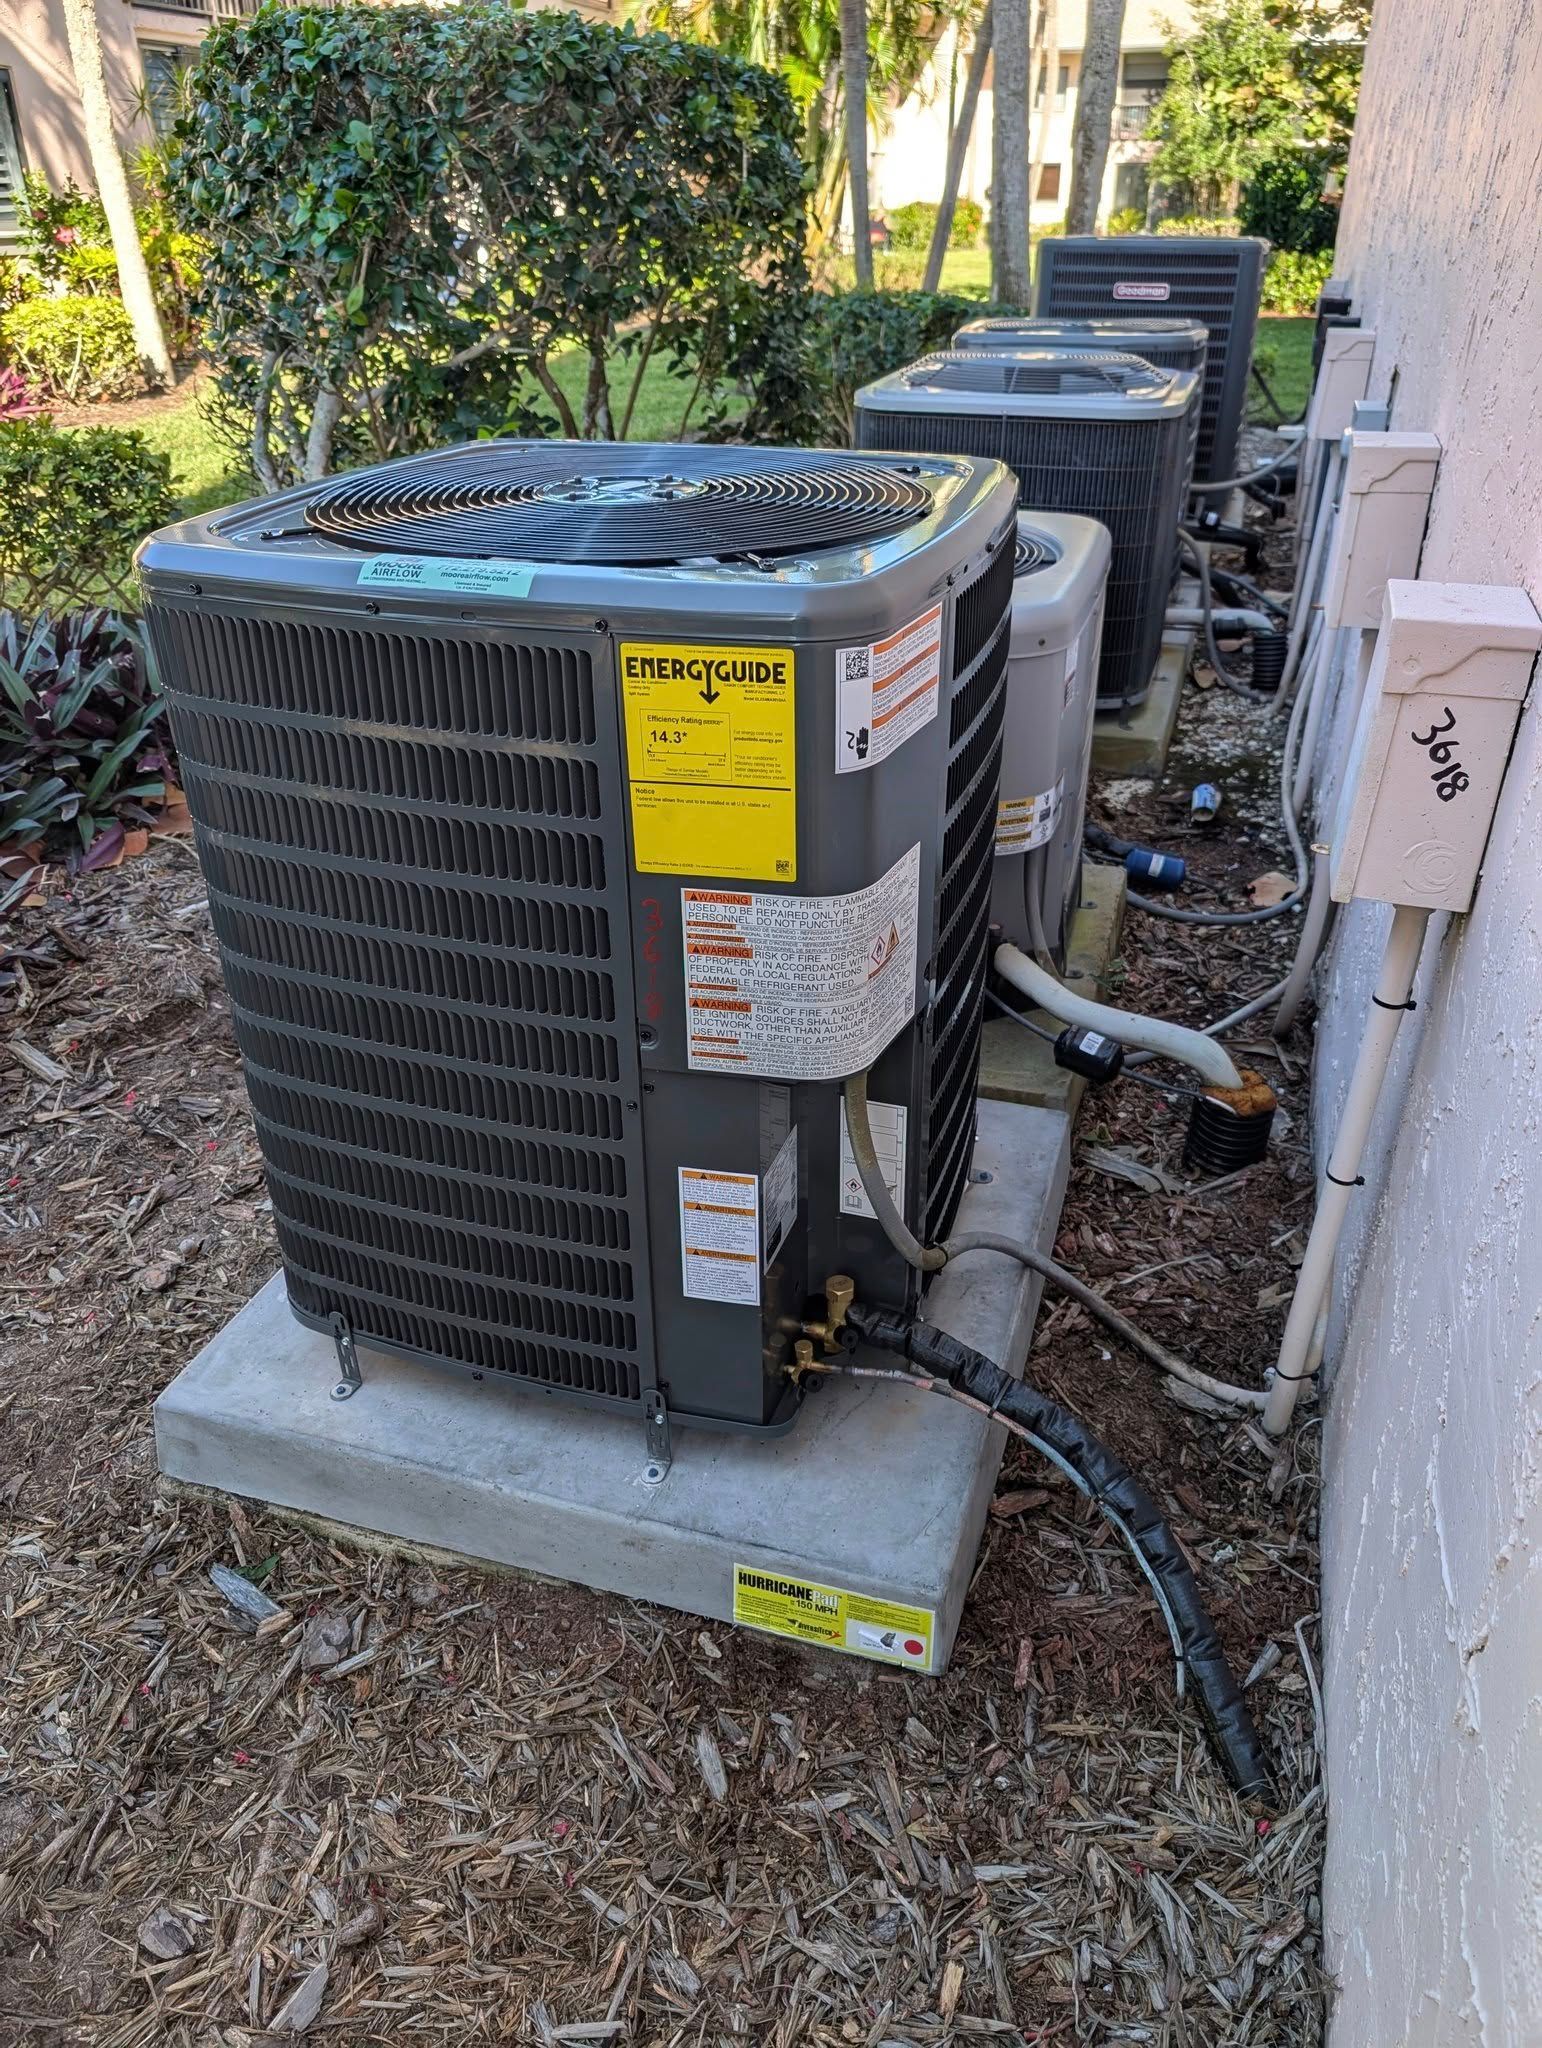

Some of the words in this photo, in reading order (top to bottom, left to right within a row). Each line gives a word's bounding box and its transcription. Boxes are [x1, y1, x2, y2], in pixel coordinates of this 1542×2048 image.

[1117, 286, 1165, 296] Goodman
[371, 568, 423, 578] AIRFLOW
[374, 561, 428, 570] MOORE
[440, 572, 509, 582] mooreairflow.com
[625, 656, 787, 688] ENERGYGUIDE
[647, 714, 679, 724] Efficiency
[680, 716, 702, 726] Rating
[1411, 706, 1470, 803] 3618
[688, 902, 720, 913] USED.
[722, 906, 737, 914] TO
[740, 907, 753, 916] BE
[756, 908, 808, 920] REPAIRED
[812, 910, 842, 920] ONLY
[842, 907, 856, 918] BY
[857, 891, 882, 912] TRAINED
[698, 892, 749, 906] WARNING
[756, 897, 779, 908] RISK
[782, 899, 796, 909] OF
[800, 901, 824, 910] FIRE
[832, 885, 880, 908] FLAMMABLE
[688, 912, 754, 925] PERSONNEL.
[756, 917, 772, 926] DO
[774, 920, 796, 928] NOT
[800, 918, 855, 929] PUNCTURE
[700, 946, 750, 958] WARNING
[754, 950, 778, 960] RISK
[780, 953, 796, 962] OF
[798, 954, 821, 963] FIRE
[830, 944, 868, 962] DISPOSE
[688, 954, 702, 963] OF
[706, 956, 760, 968] PROPERLY
[762, 961, 773, 970] IN
[776, 962, 847, 972] ACCORDANCE
[850, 955, 869, 967] WITH
[690, 964, 736, 976] FEDERAL
[740, 968, 755, 976] OR
[758, 970, 791, 980] LOCAL
[794, 966, 864, 982] REGULATIONS.
[690, 974, 750, 986] FLAMMABLE
[753, 980, 826, 992] REFRIGERANT
[828, 980, 856, 991] USED.
[702, 1000, 749, 1011] WARNING
[756, 1006, 780, 1014] RISK
[782, 1008, 797, 1016] OF
[800, 1009, 822, 1017] FIRE
[830, 996, 872, 1016] AUXILIARY
[692, 1008, 706, 1018] BE
[708, 1010, 753, 1021] IGNITION
[755, 1014, 804, 1026] SOURCES
[806, 1016, 839, 1026] SHALL
[840, 1012, 859, 1022] NOT
[860, 1007, 870, 1018] BE
[694, 1018, 754, 1030] DUCTWORK,
[756, 1023, 791, 1034] OTHER
[794, 1026, 820, 1035] THAN
[823, 1016, 868, 1034] AUXILIARY
[694, 1028, 714, 1036] USE
[716, 1029, 742, 1038] WITH
[744, 1032, 764, 1041] THE
[766, 1034, 812, 1045] SPECIFIC
[815, 1026, 865, 1044] APPLIANCE.
[709, 1174, 739, 1182] WARNING
[814, 1604, 838, 1616] MPH
